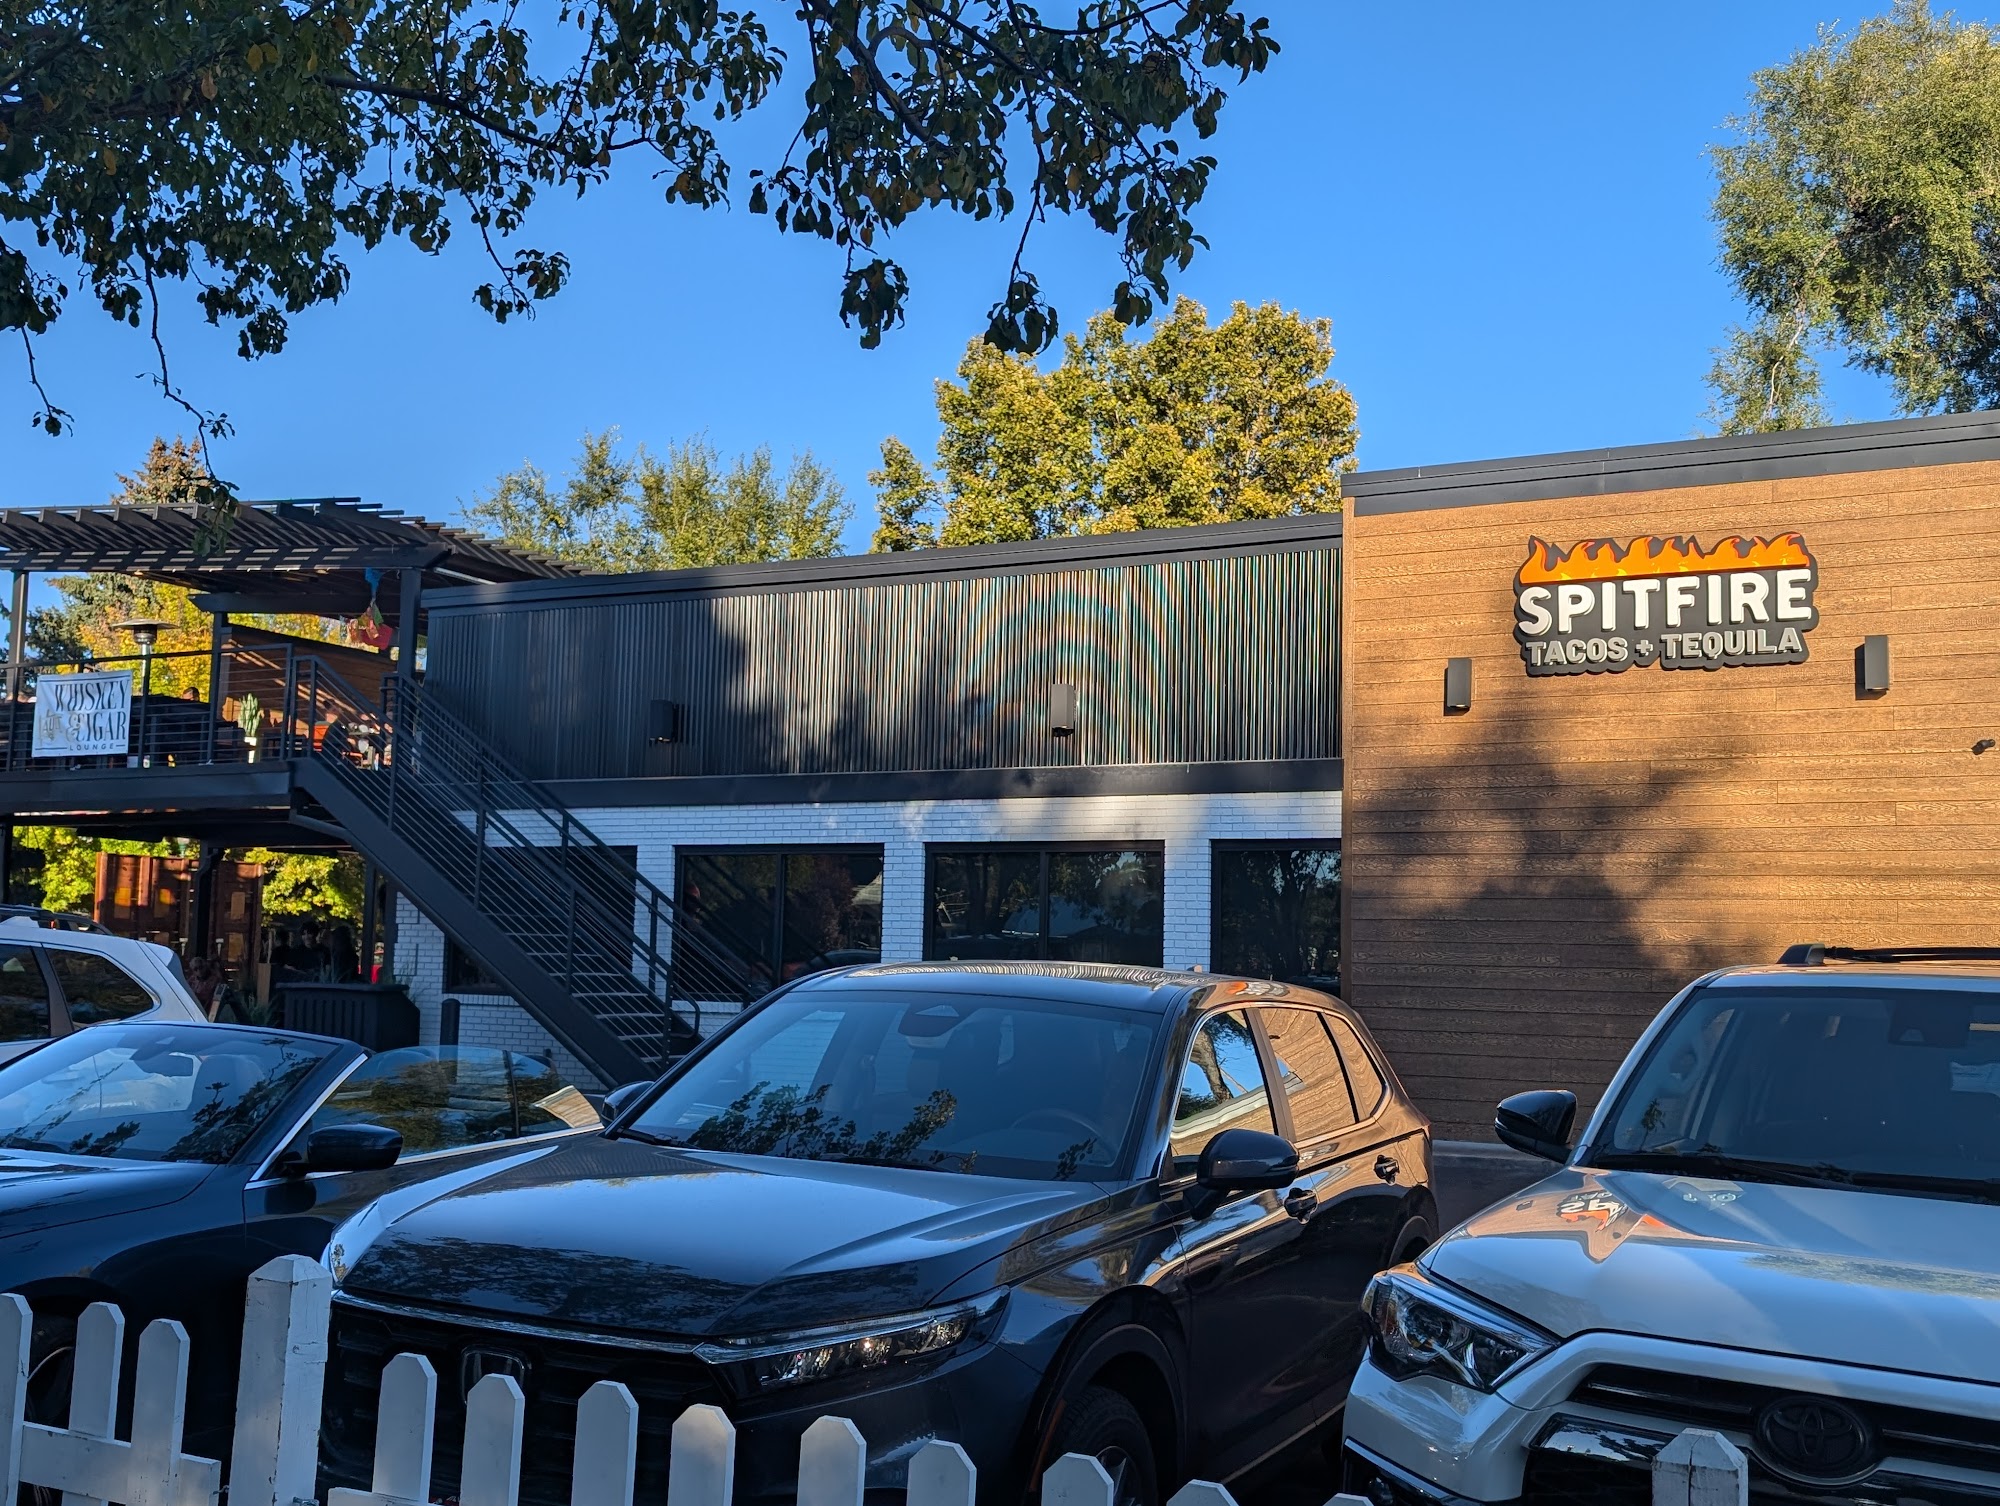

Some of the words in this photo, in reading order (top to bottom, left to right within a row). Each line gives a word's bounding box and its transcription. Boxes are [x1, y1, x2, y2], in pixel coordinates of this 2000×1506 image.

[1518, 568, 1811, 636] SPITFIRE
[1526, 636, 1629, 666] TACOS
[1661, 627, 1802, 661] TEQUILA
[55, 680, 130, 711] WHISKEY
[76, 711, 126, 742] CIGAR
[69, 742, 114, 751] LOUNGE
